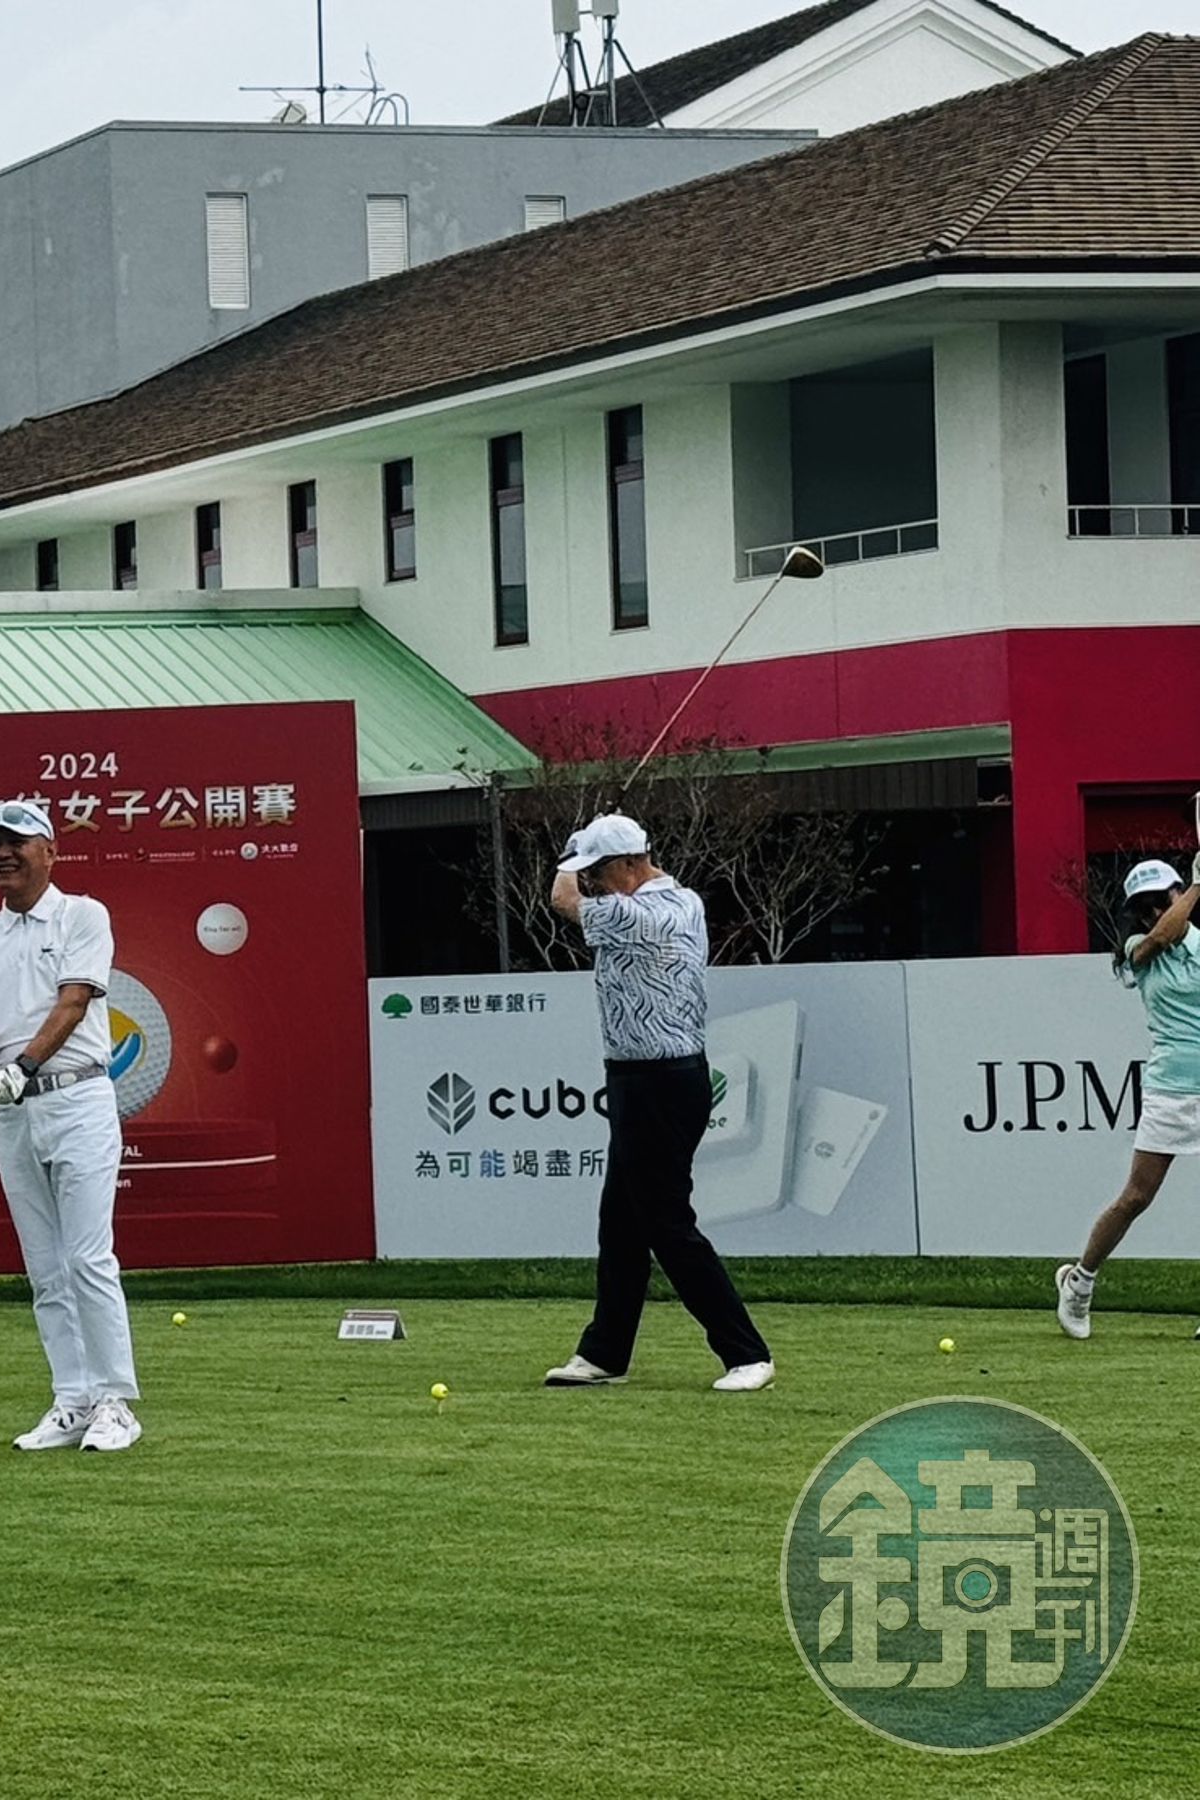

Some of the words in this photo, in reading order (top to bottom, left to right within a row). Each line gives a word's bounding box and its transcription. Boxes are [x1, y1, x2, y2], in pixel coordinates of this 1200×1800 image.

[40, 752, 119, 779] 2024
[420, 993, 547, 1015] 國泰世華銀行
